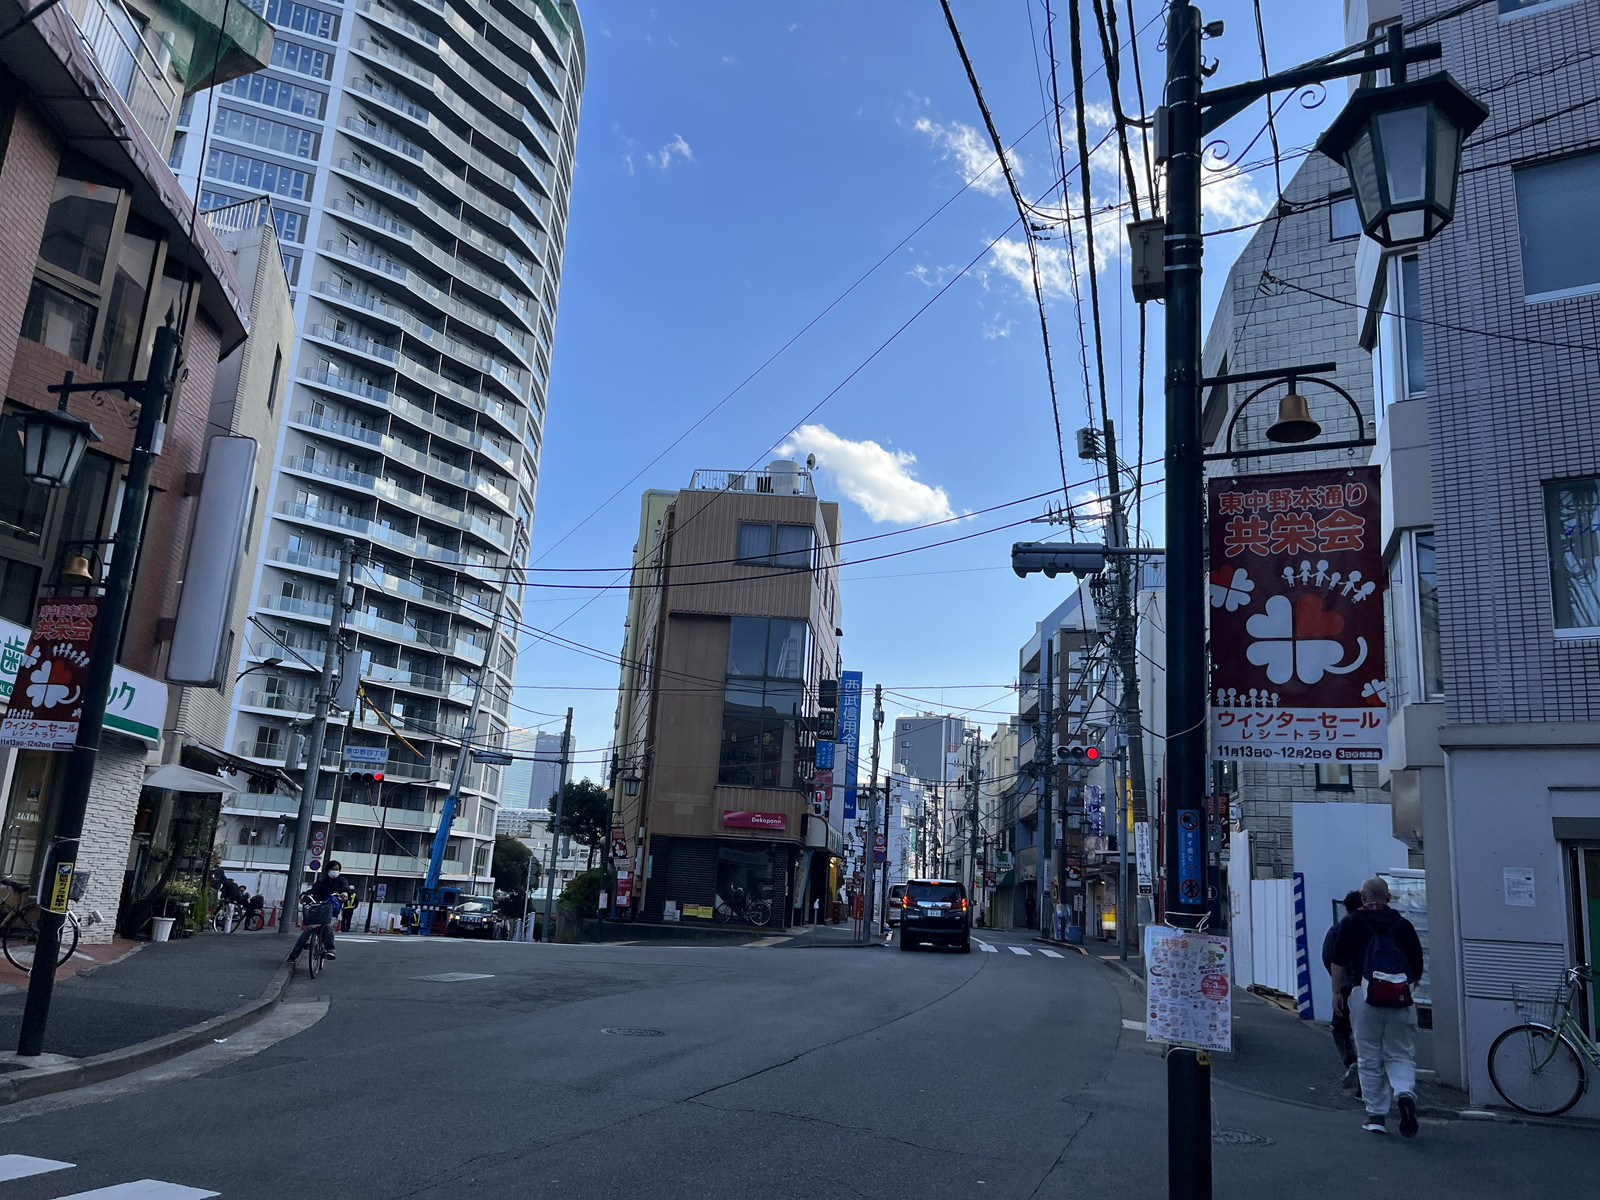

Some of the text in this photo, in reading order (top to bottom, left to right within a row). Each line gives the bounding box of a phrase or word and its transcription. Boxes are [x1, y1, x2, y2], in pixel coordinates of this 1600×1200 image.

[1218, 483, 1368, 515] 東中野本通り
[1223, 508, 1366, 557] 共栄会
[39, 604, 98, 618] 東中野本通り
[33, 617, 93, 641] 共栄会
[5, 720, 77, 733] ウィンターセール
[1217, 710, 1381, 729] ウィンターセール
[12, 731, 64, 739] レシートラリー
[1241, 728, 1356, 741] レシートラリー
[346, 747, 388, 758] 東中野四丁目
